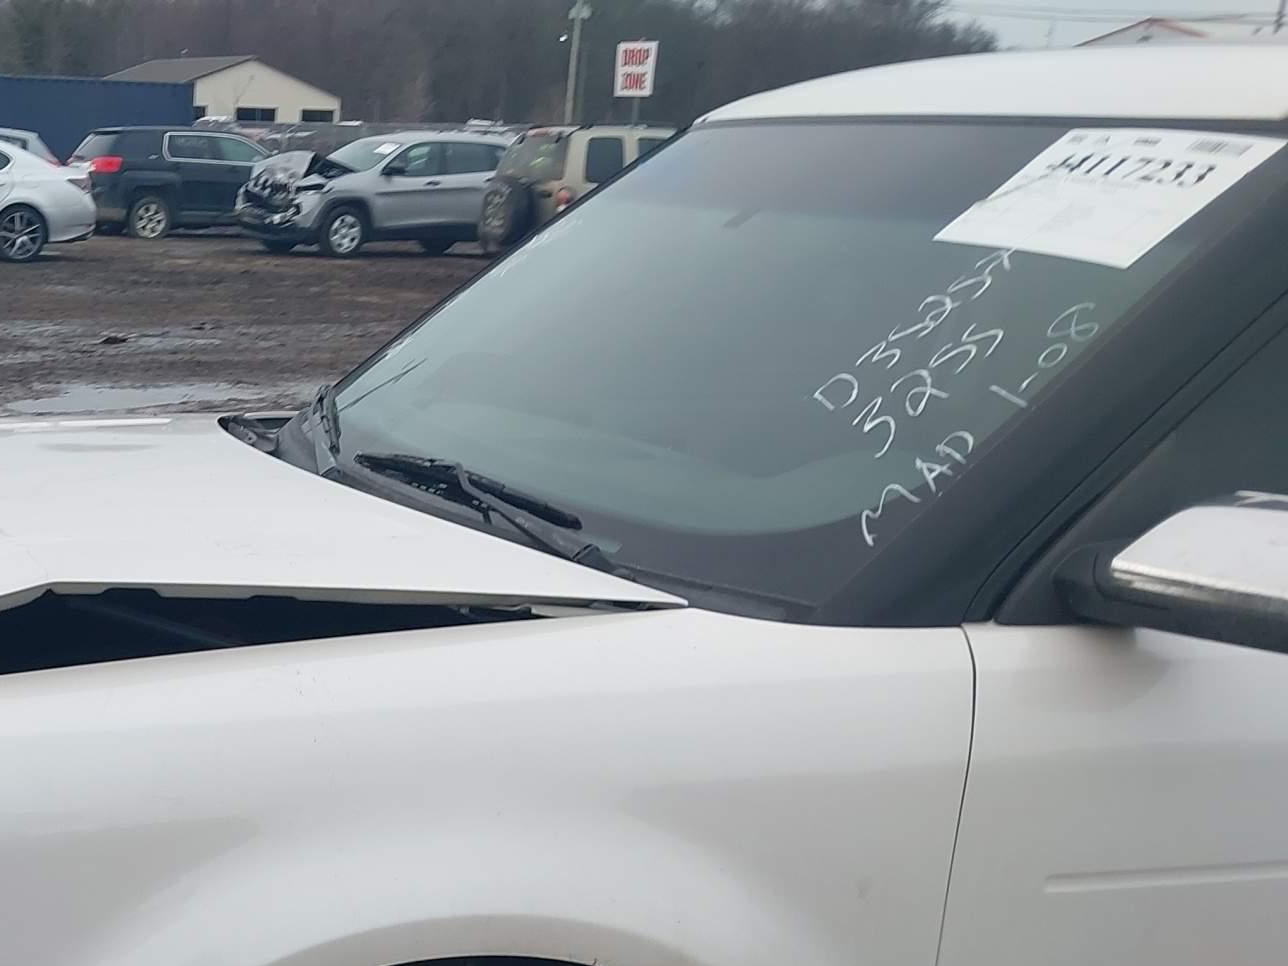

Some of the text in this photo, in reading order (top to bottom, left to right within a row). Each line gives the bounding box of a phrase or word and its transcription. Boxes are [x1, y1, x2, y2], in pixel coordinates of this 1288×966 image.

[621, 48, 649, 66] DROP
[621, 71, 648, 90] ZONE
[861, 431, 974, 547] MAD
